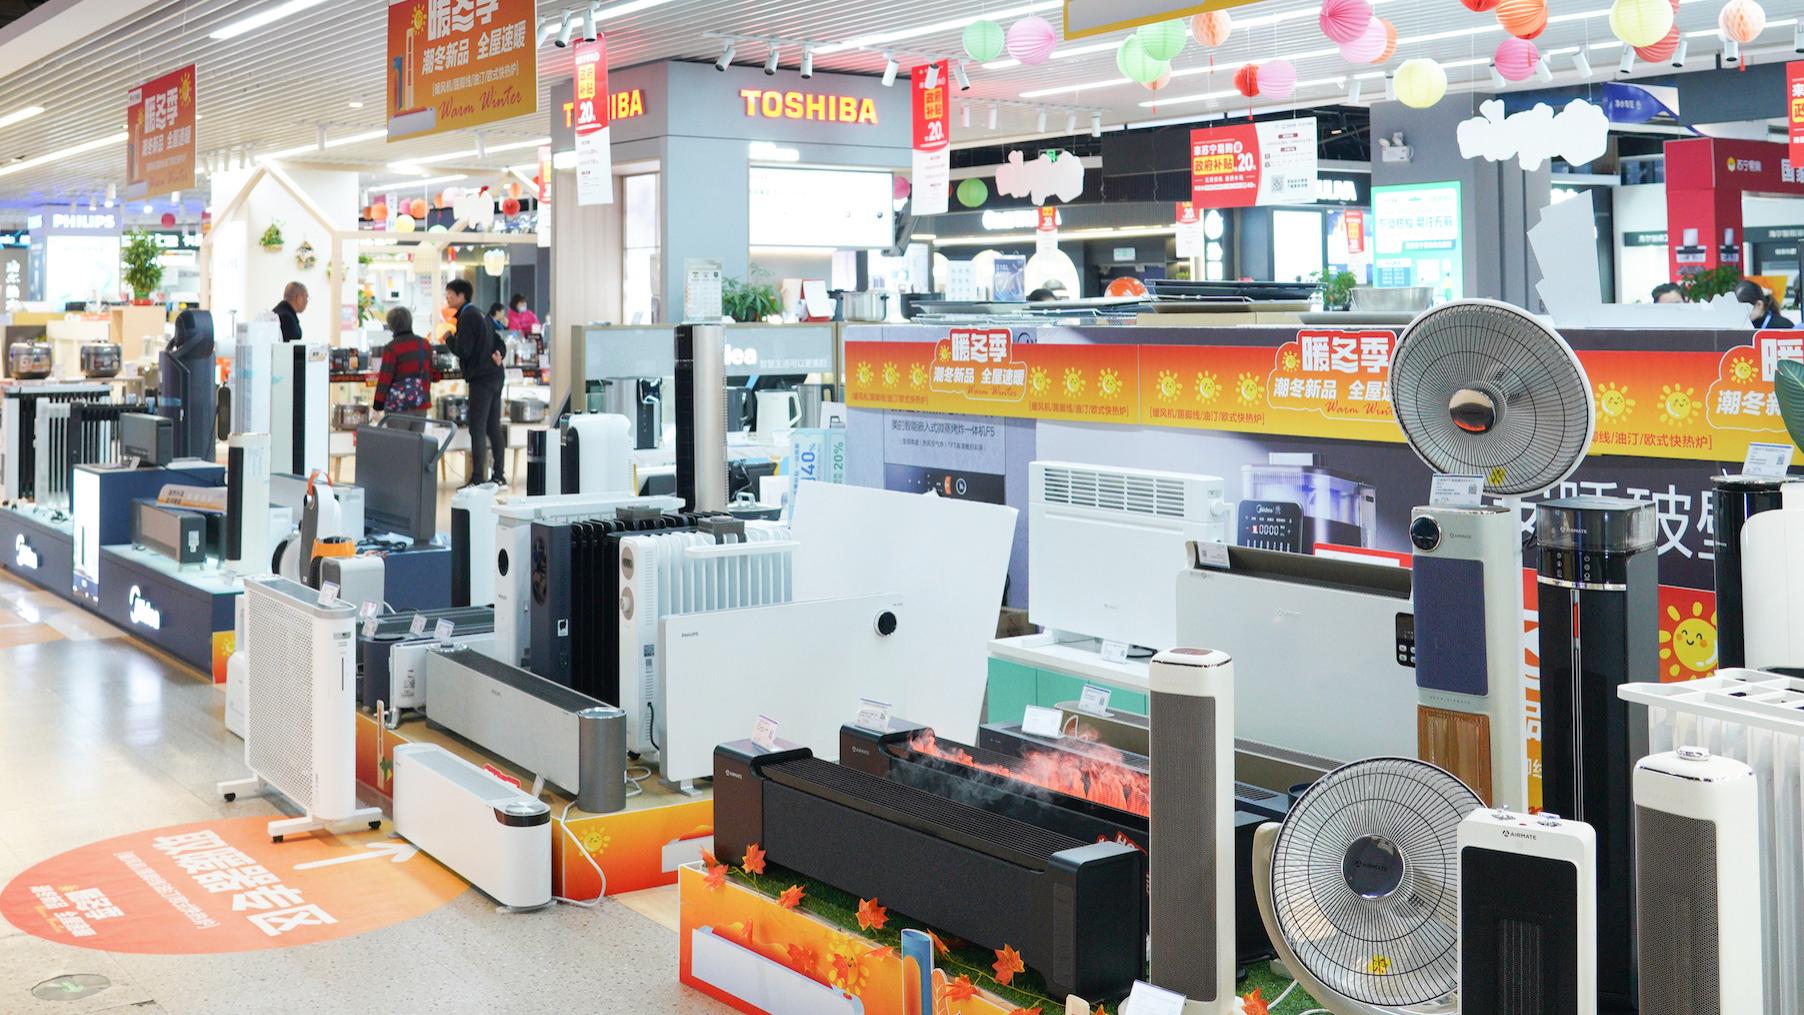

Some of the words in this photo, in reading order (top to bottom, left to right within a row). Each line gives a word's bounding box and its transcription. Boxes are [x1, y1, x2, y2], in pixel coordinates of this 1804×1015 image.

[422, 38, 469, 75] 潮冬新品
[477, 20, 527, 60] 全屋速暖
[144, 86, 178, 134] 暖冬季
[439, 96, 475, 120] Warm
[479, 84, 523, 111] Winter
[563, 89, 644, 128] TIBA
[740, 89, 879, 124] TOSHIBA
[1194, 157, 1232, 172] 政府补贴
[52, 213, 116, 229] PHILIPS
[952, 333, 1007, 363] 暖冬季
[1301, 336, 1389, 374] 暖冬季
[933, 367, 975, 384] 潮冬新品
[981, 368, 1025, 386] 全屋速暖
[1273, 377, 1337, 400] 潮冬新品
[1325, 399, 1359, 415] Warm
[1510, 832, 1536, 840] AIRMATE
[152, 829, 339, 937] 取暖器专区
